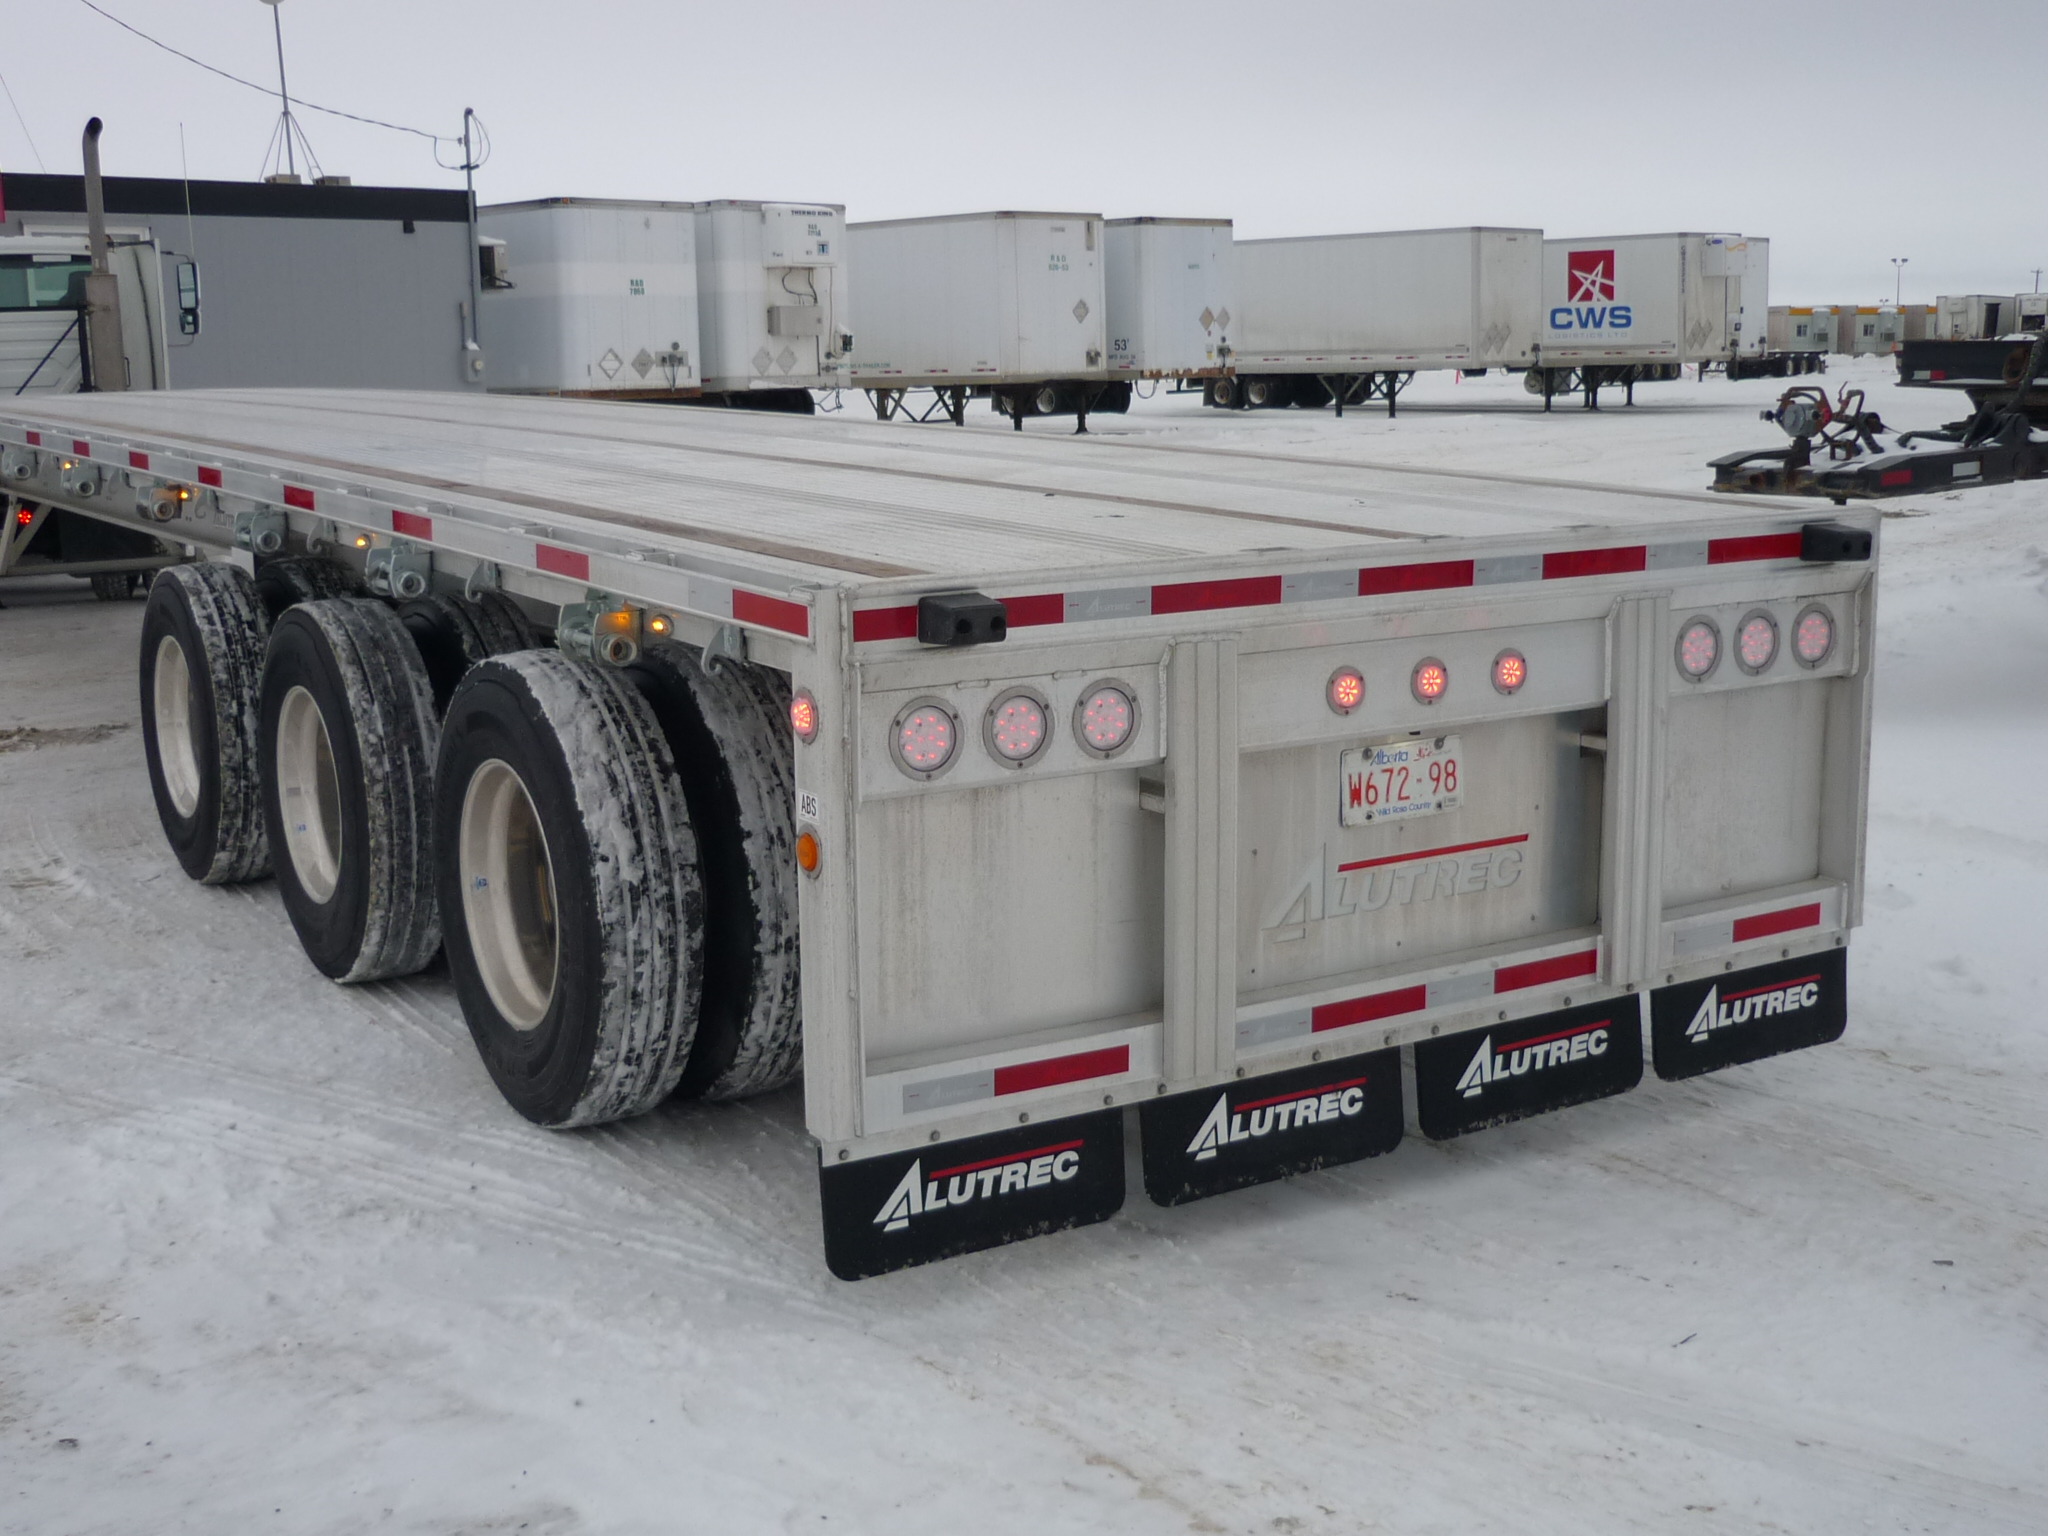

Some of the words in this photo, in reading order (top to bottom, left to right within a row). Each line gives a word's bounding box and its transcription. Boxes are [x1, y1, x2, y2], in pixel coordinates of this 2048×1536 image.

[1547, 332, 1603, 340] LOGISTICS
[1607, 331, 1628, 339] LTD
[1549, 306, 1632, 330] CWS
[1370, 749, 1409, 766] Alberta
[801, 793, 817, 817] ABS
[1375, 807, 1391, 817] Wild
[1261, 842, 1524, 944] ALUTREC
[1684, 981, 1819, 1043] ALUTREC
[1454, 1028, 1609, 1100] ALUTREC
[1185, 1086, 1366, 1161] ALUTREC
[872, 1149, 1080, 1232] ALUTREC
